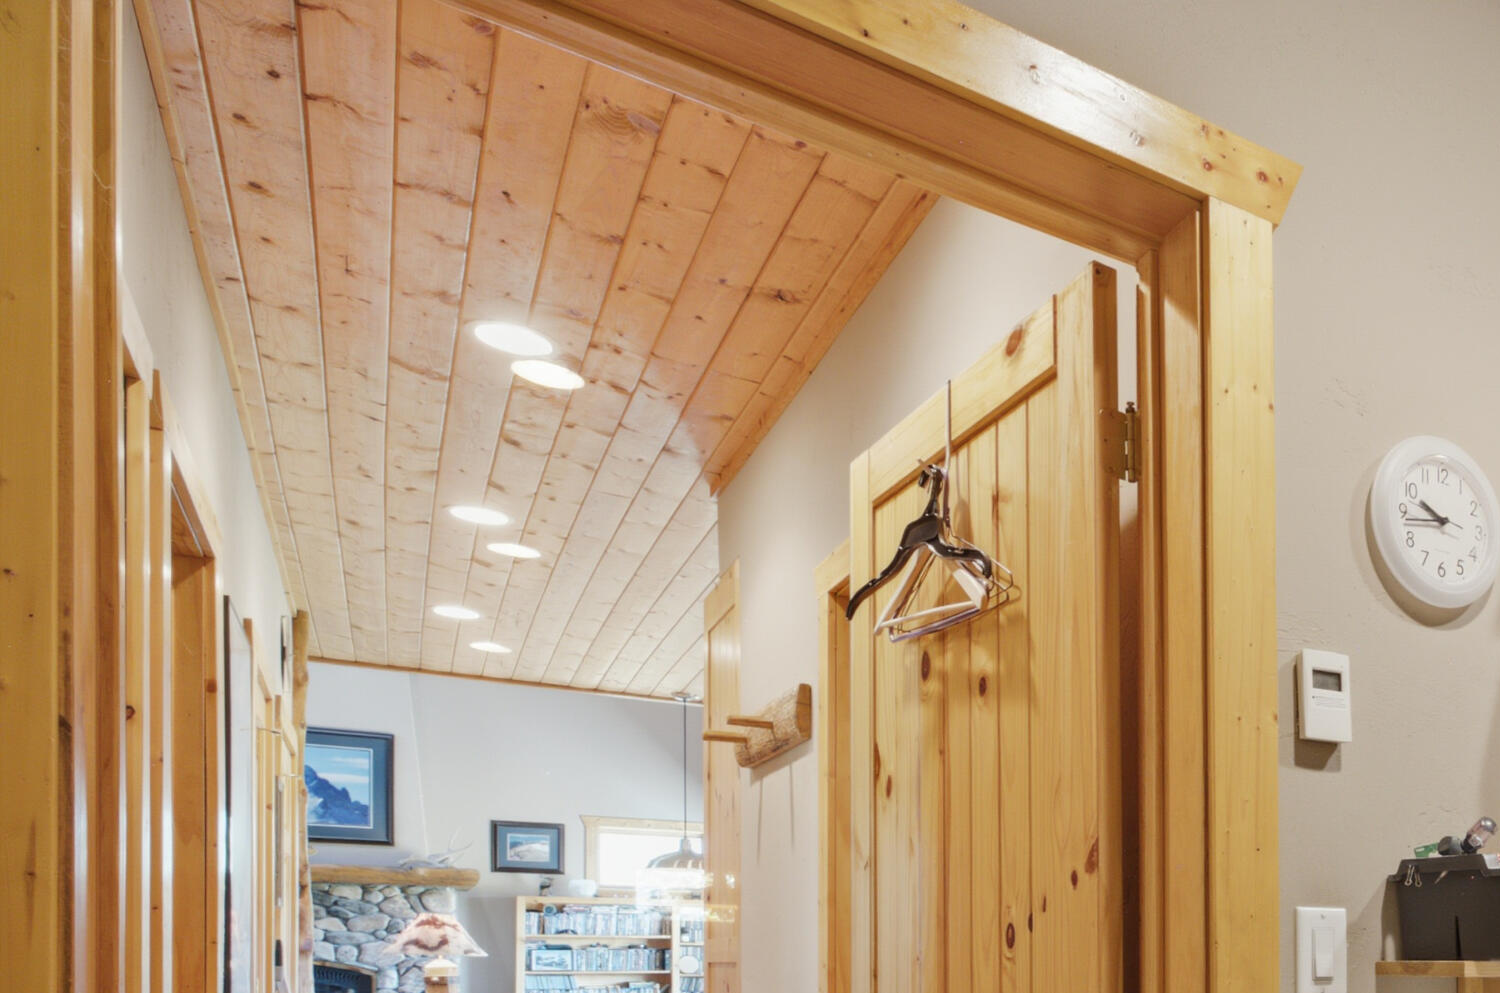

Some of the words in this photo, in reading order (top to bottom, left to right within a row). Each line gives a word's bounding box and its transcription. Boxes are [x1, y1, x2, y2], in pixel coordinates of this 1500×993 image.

[1421, 468, 1430, 485] 11
[1437, 468, 1449, 485] 12
[1405, 481, 1418, 499] 10
[1399, 502, 1408, 519] 9
[1470, 500, 1478, 517] 2
[1405, 530, 1415, 548] 8
[1474, 525, 1484, 541] 3
[1421, 550, 1429, 566] 7
[1468, 546, 1478, 562] 4
[1437, 561, 1446, 578] 6
[1456, 559, 1465, 576] 5
